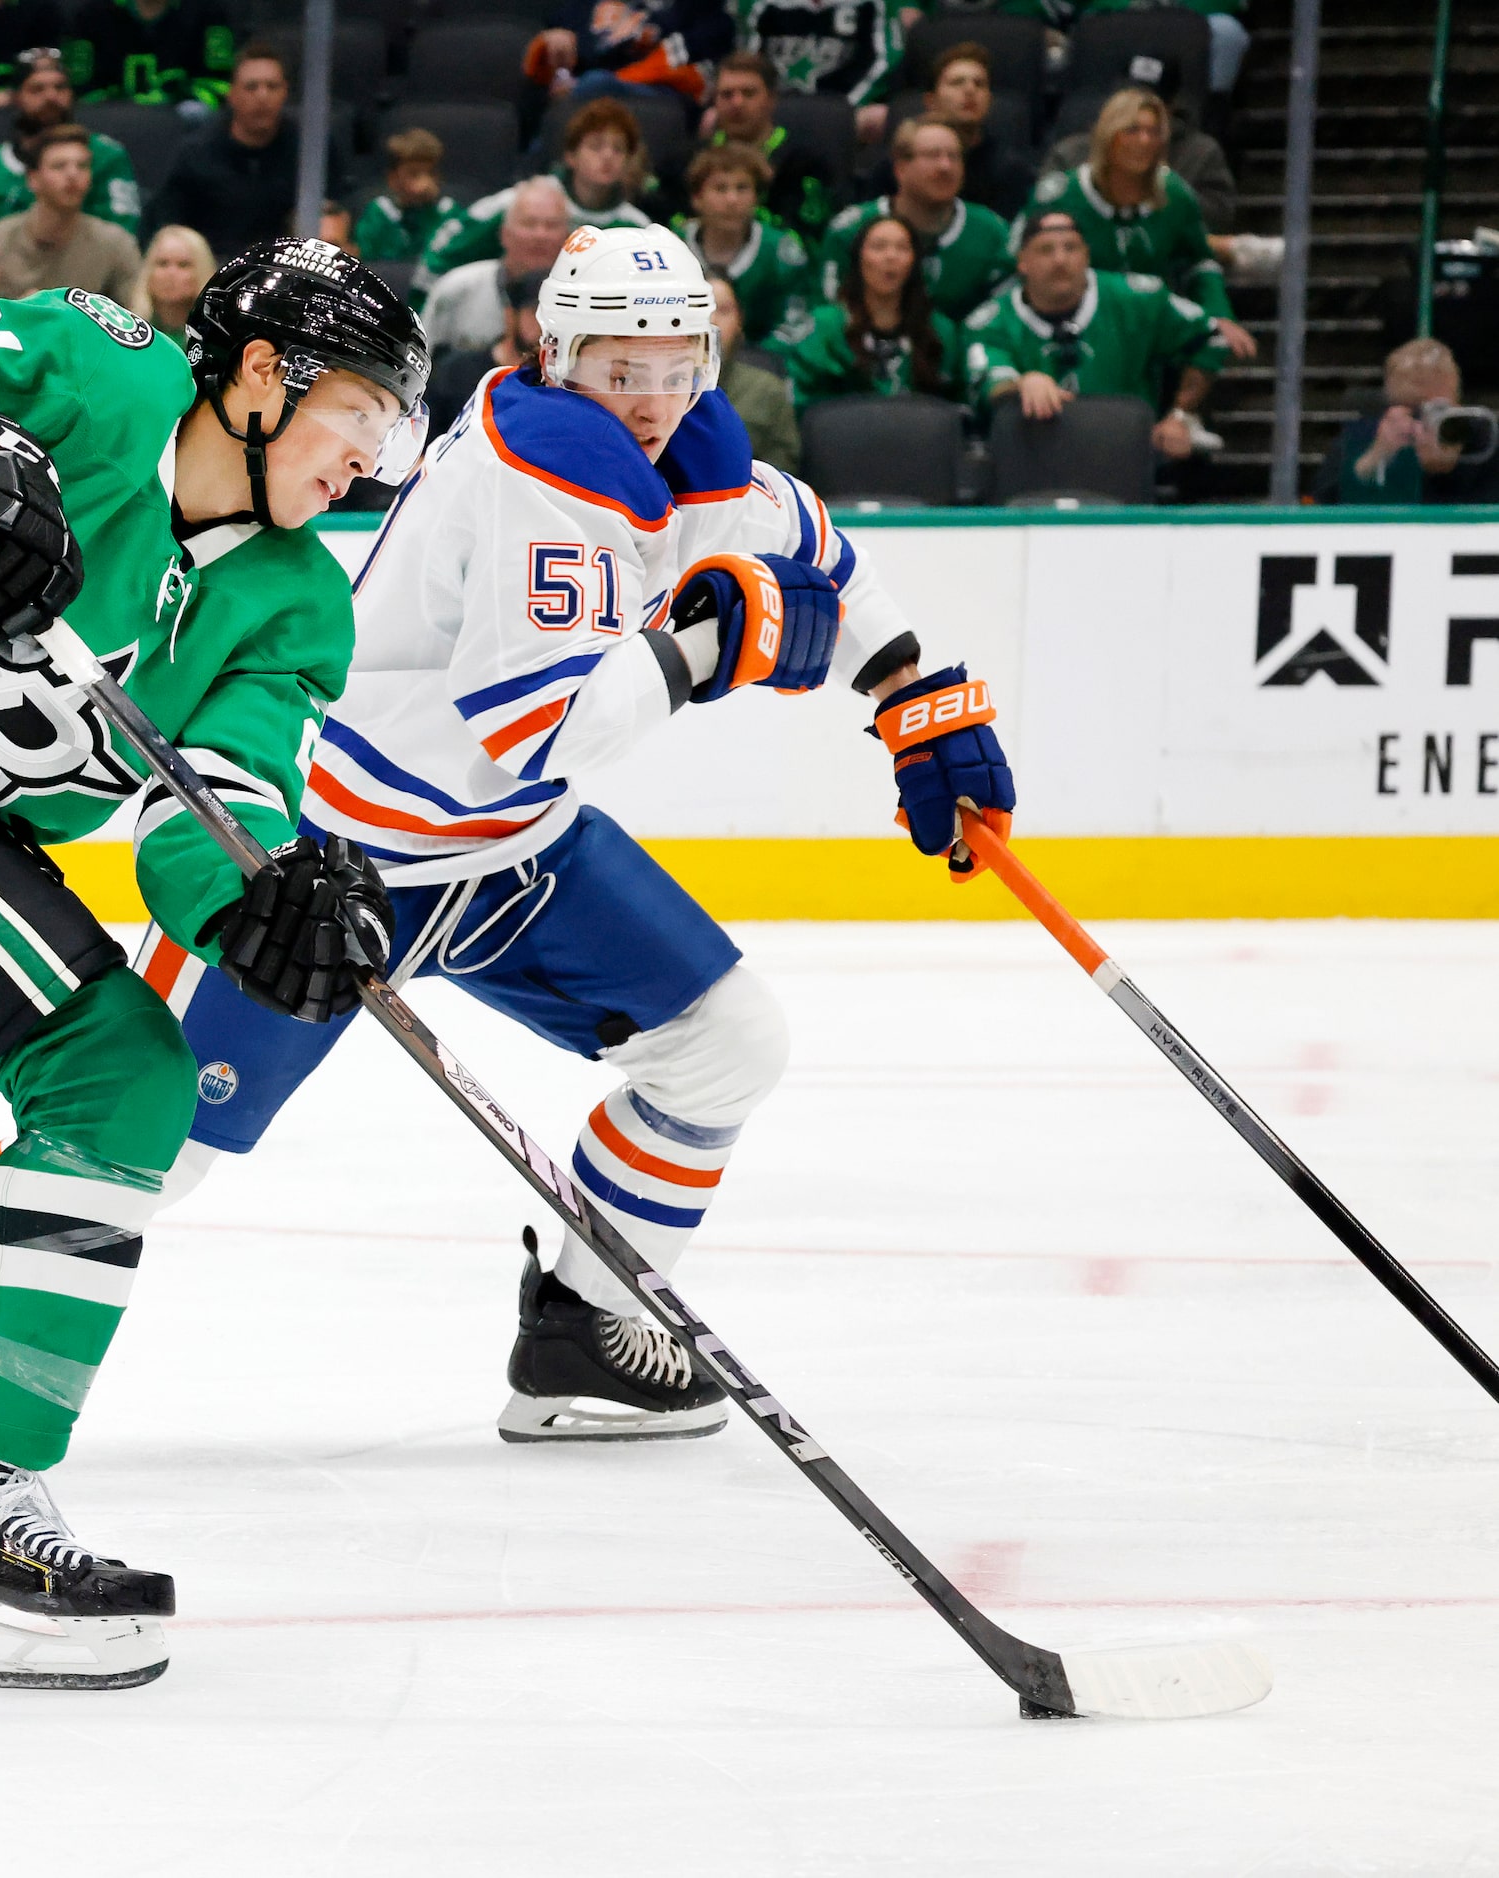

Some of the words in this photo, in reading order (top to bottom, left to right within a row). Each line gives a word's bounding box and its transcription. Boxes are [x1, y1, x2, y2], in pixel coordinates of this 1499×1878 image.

[272, 252, 344, 283] TRANSFER
[283, 246, 341, 269] ENERGY
[631, 251, 670, 271] 51
[528, 542, 624, 636] 51
[899, 685, 996, 736] BAU
[486, 1102, 515, 1132] PRO
[637, 1271, 830, 1462] CCM
[864, 1533, 913, 1580] CCM
